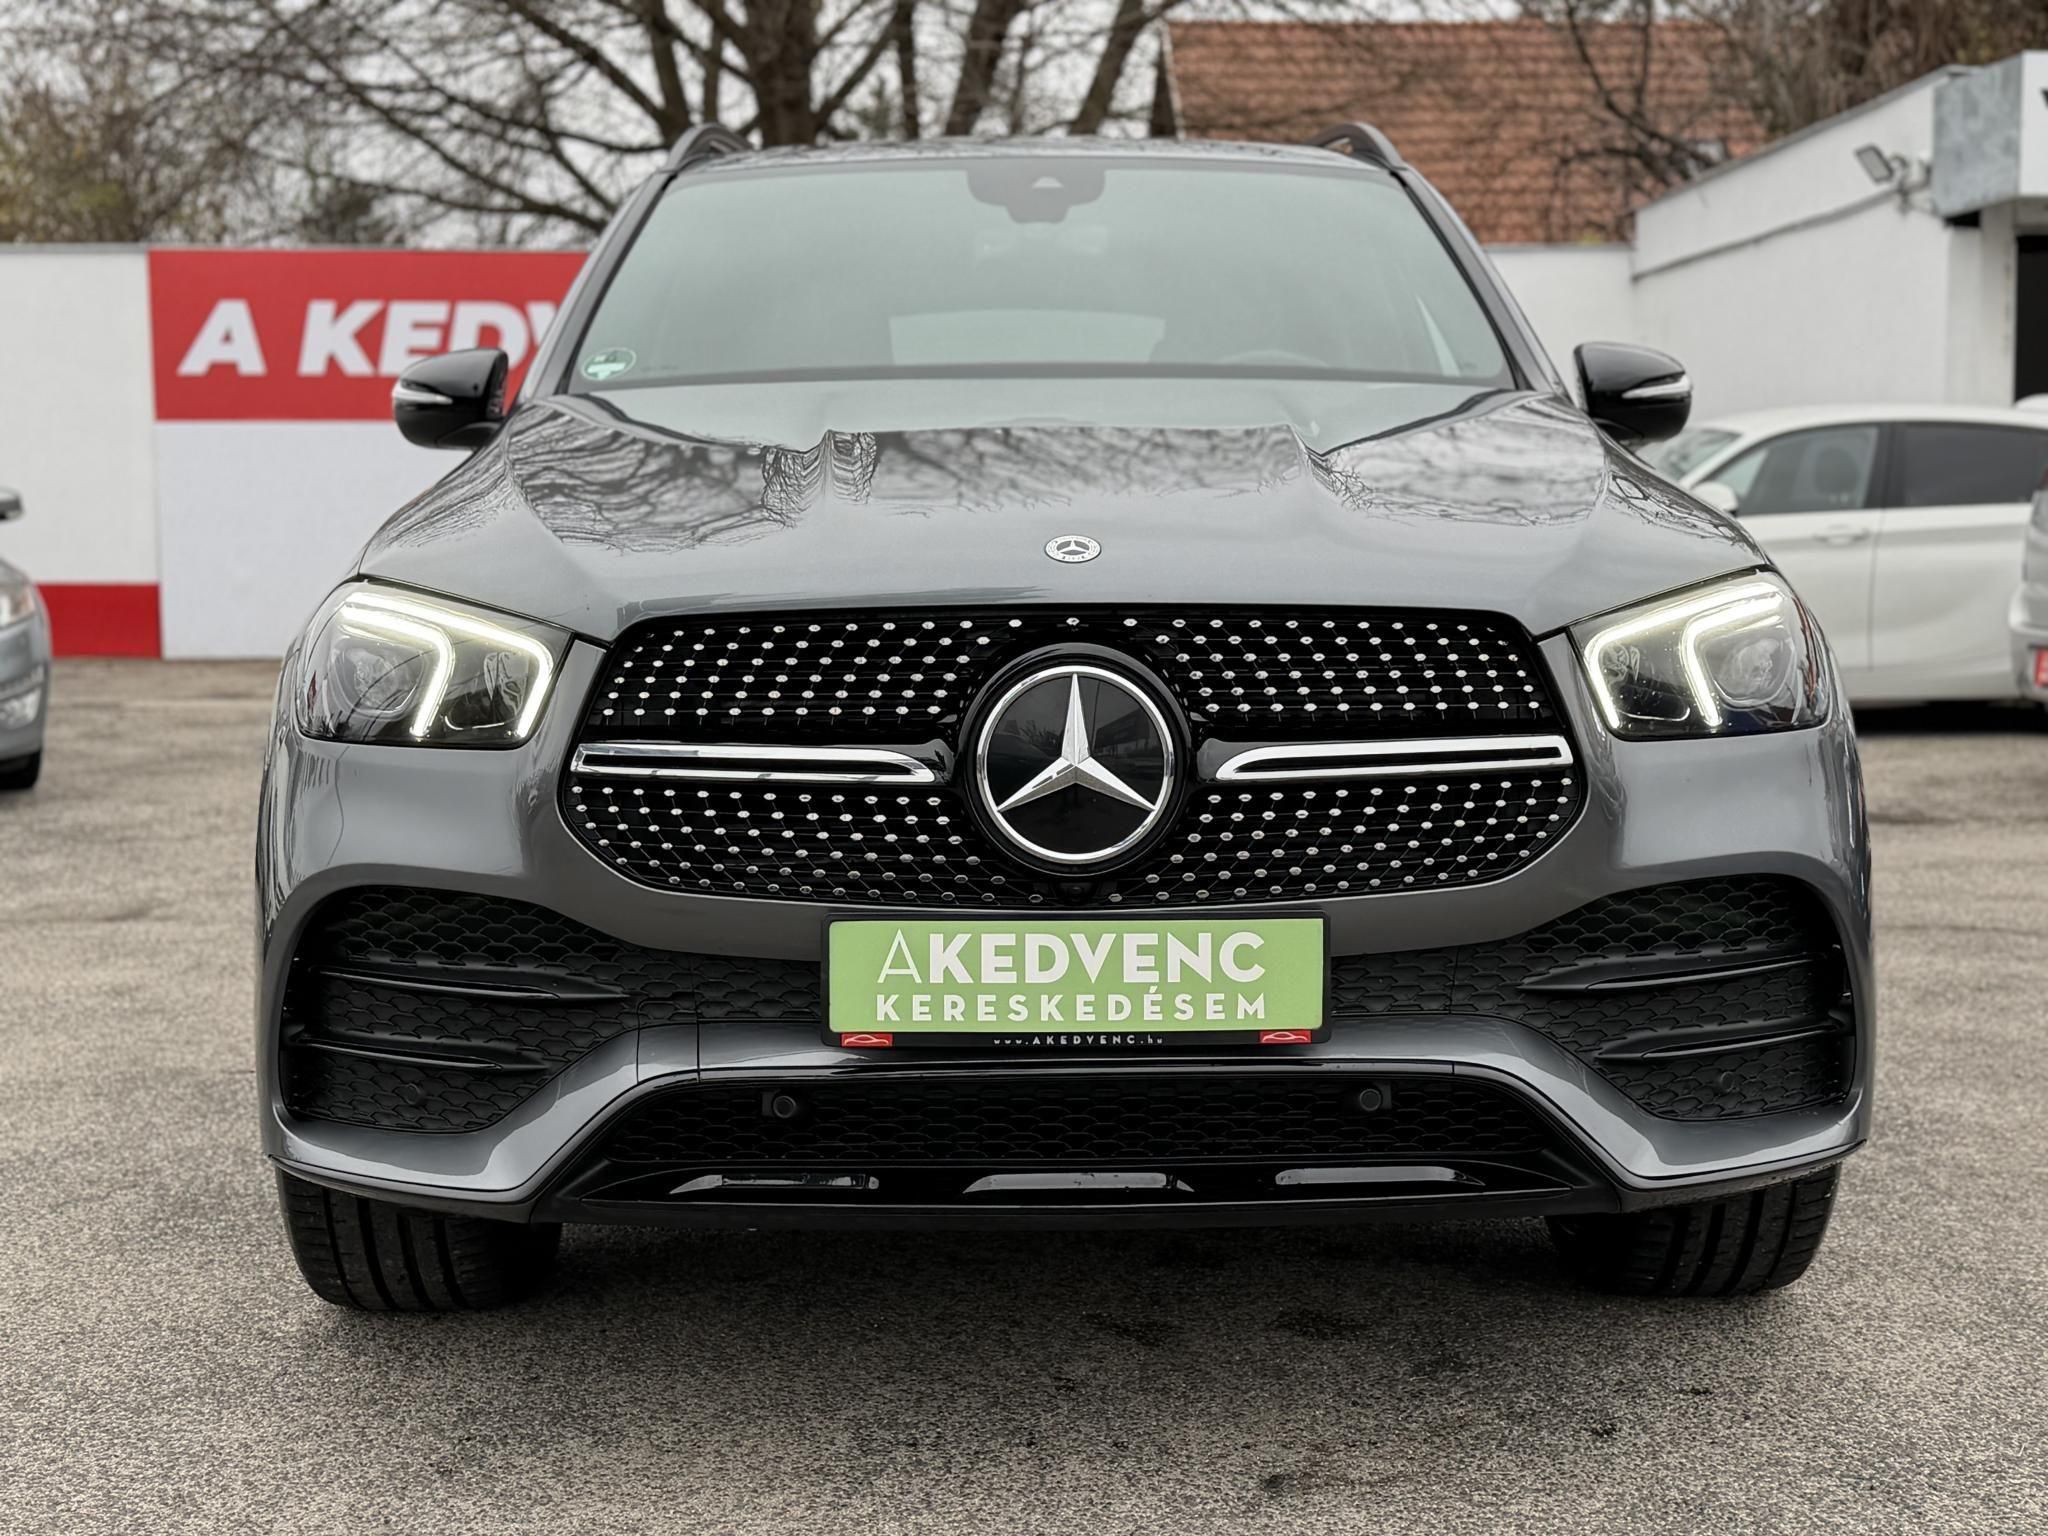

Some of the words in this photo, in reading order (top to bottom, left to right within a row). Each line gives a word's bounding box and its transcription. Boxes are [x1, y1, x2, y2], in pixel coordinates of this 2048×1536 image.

[176, 298, 267, 376] A
[876, 985, 1266, 1022] KERESKEDÉSEM
[993, 1034, 1163, 1046] www.AKEDVENC.hu
